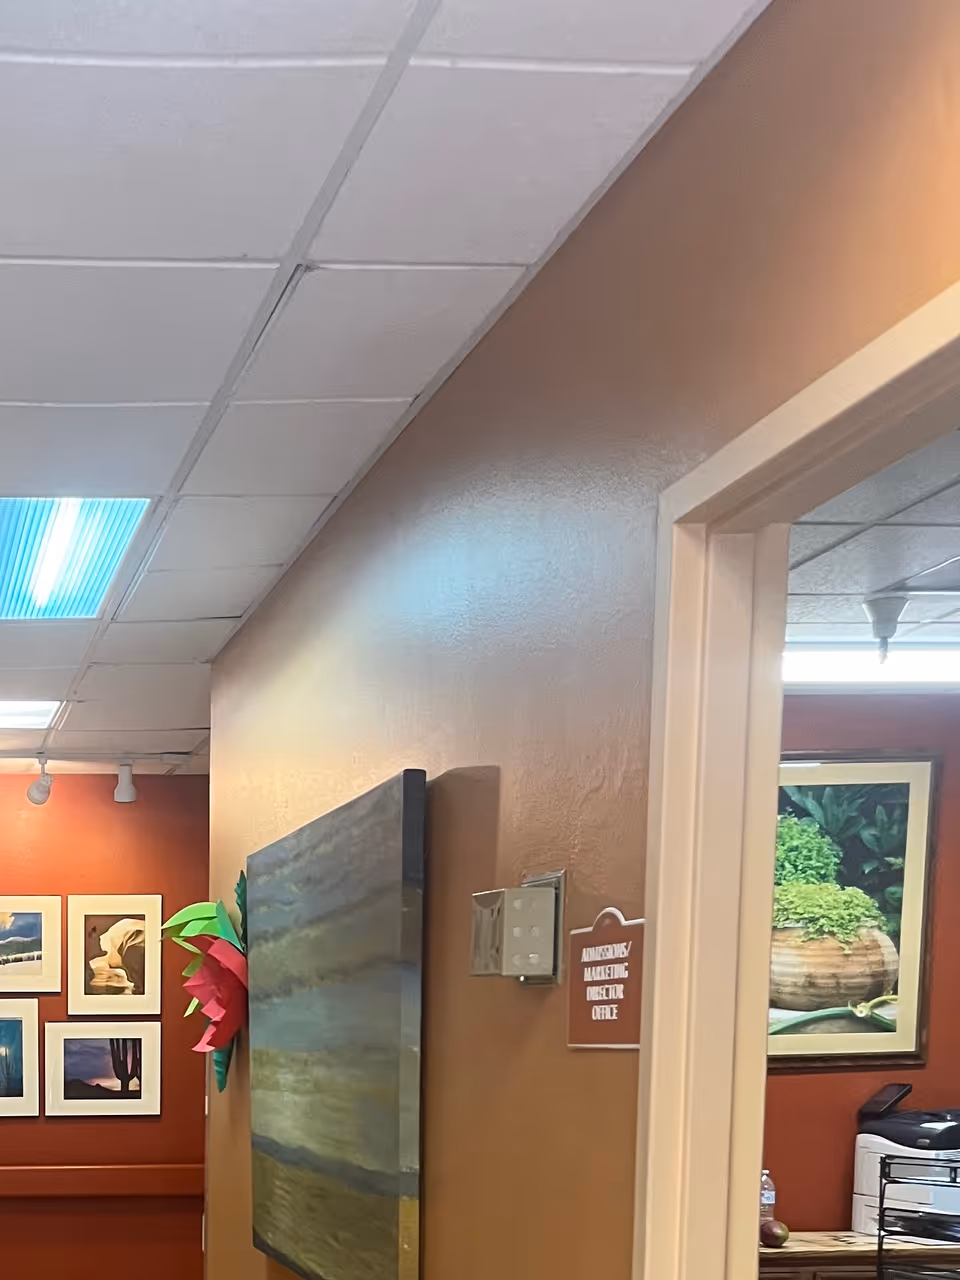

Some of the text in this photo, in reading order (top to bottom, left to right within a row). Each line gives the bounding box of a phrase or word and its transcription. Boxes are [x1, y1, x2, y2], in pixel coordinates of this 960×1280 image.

[584, 962, 629, 982] MARKETING
[586, 984, 624, 1001] DIRECTOR
[591, 1004, 618, 1020] OFFICE
